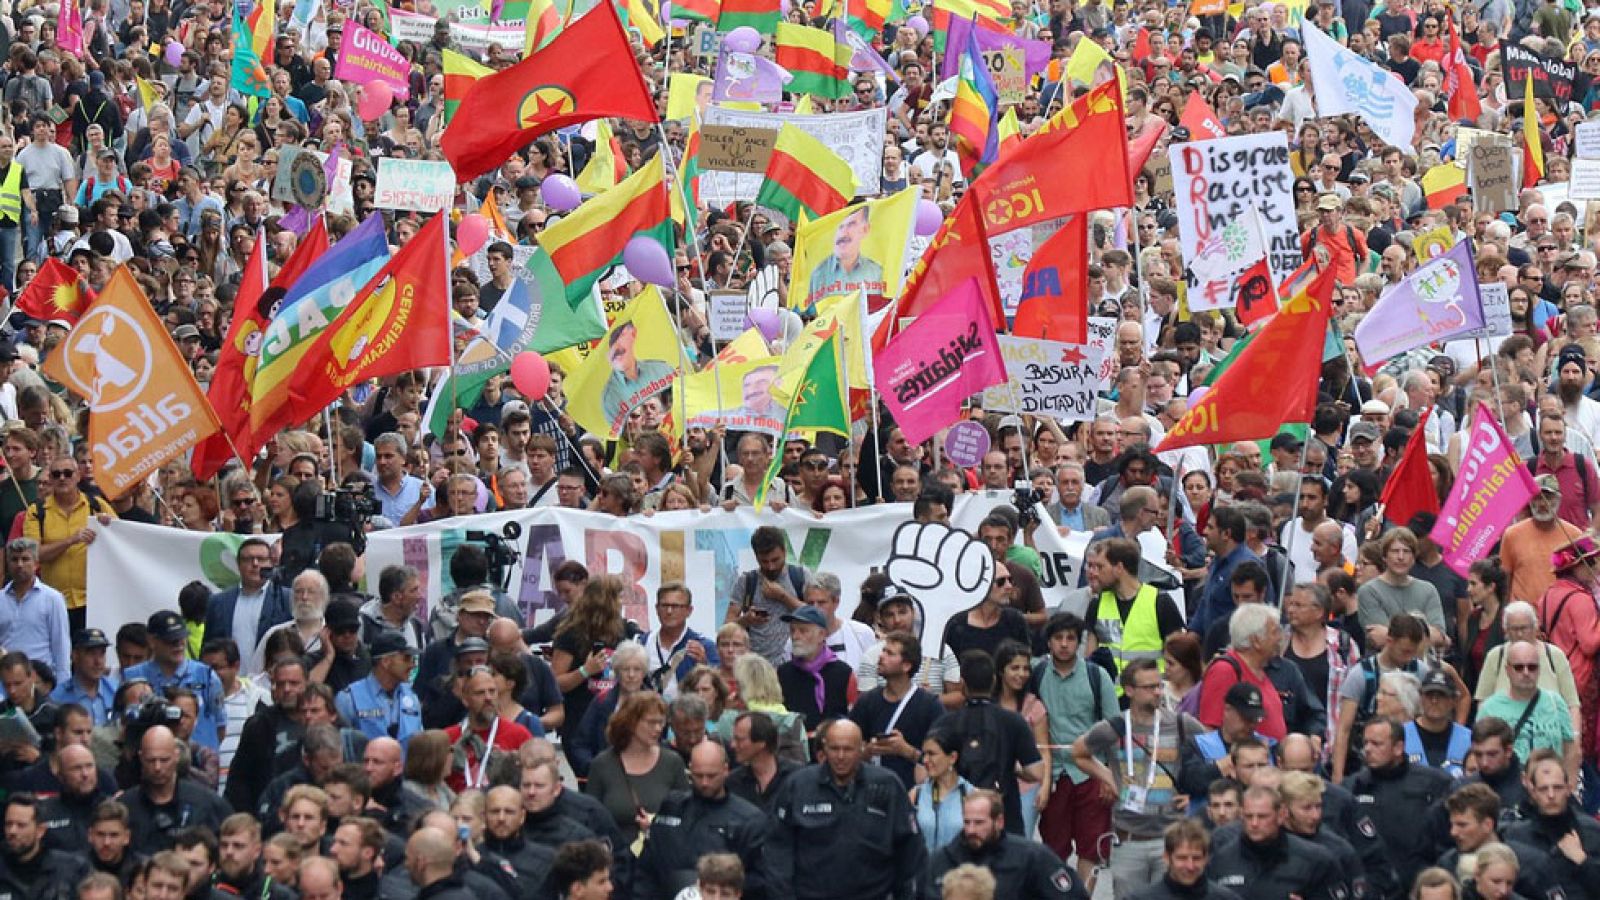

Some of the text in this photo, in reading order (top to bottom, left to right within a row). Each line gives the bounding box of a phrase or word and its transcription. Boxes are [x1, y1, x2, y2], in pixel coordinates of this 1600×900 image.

[733, 128, 746, 136] NO
[707, 158, 757, 169] VIOLENCE
[1189, 170, 1289, 205] Racist
[1022, 383, 1043, 394] LA
